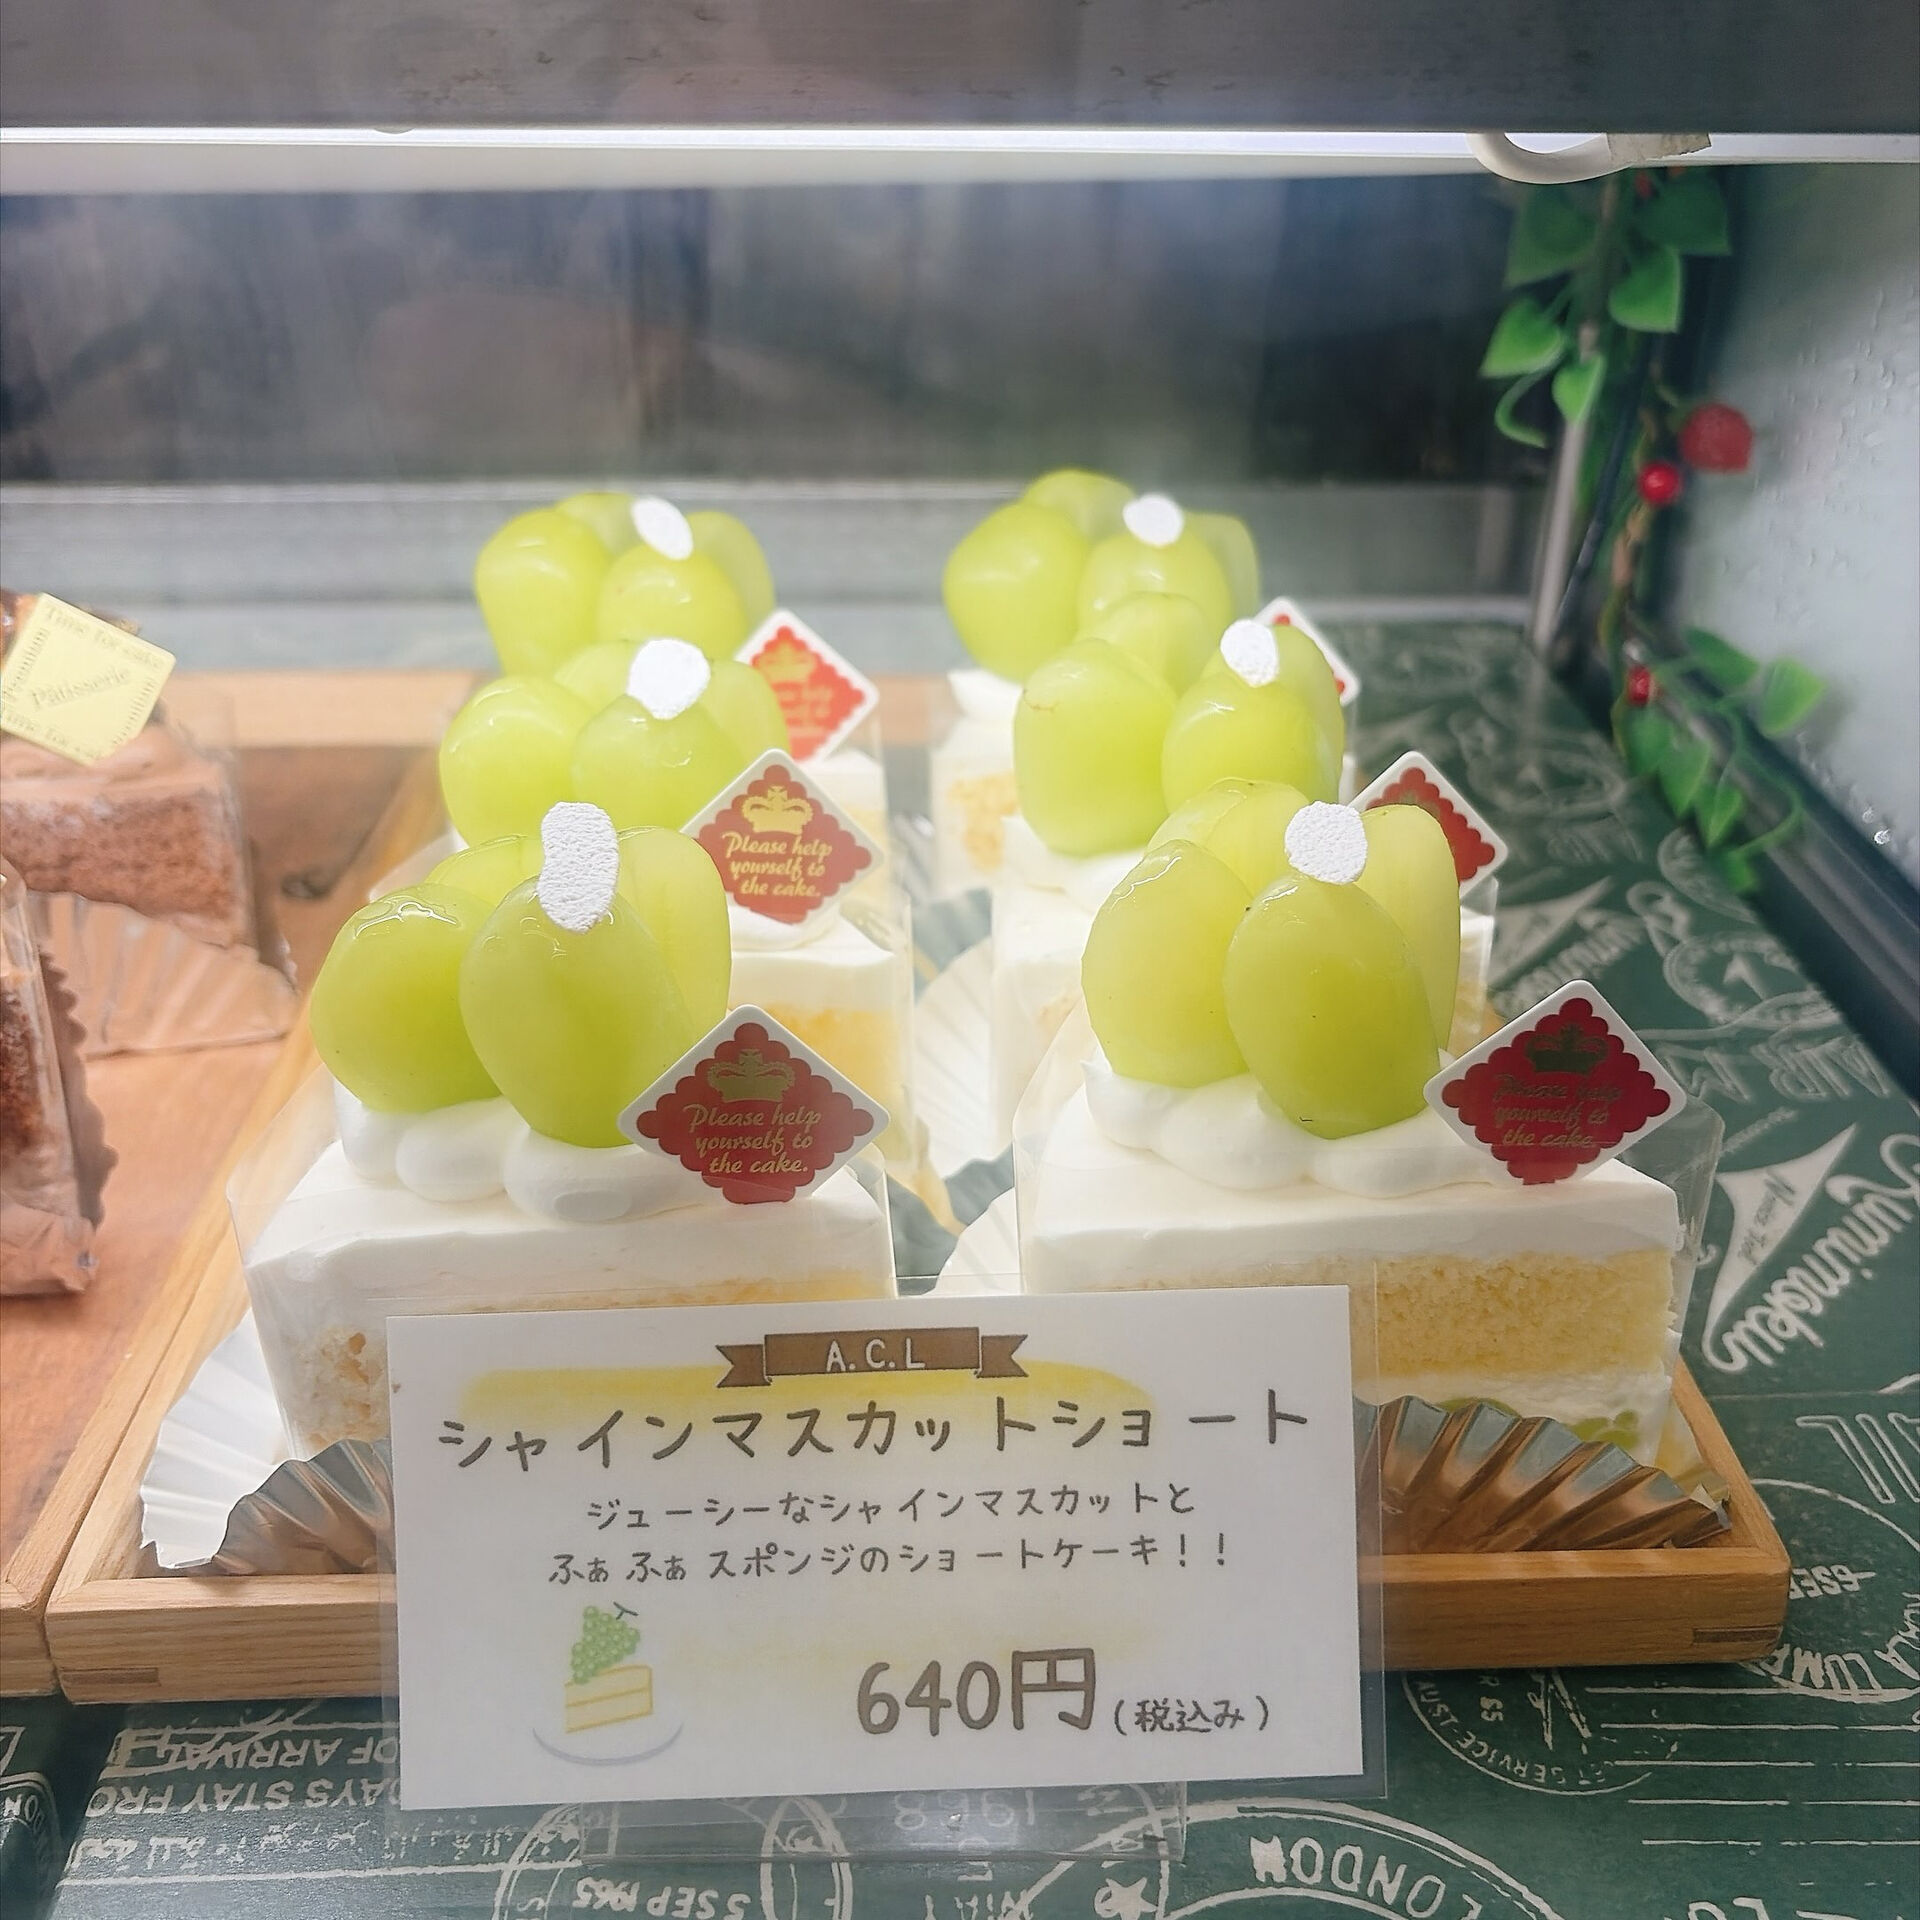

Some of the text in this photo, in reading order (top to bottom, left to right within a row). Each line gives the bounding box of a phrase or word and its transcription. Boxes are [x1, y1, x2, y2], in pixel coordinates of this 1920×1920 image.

[721, 832, 832, 858] Please help
[730, 854, 826, 882] yourself to
[741, 876, 821, 897] the cake.
[684, 1101, 821, 1133] Please help
[1587, 1107, 1611, 1124] to
[695, 1126, 814, 1158] yourself to
[1502, 1123, 1534, 1146] the
[709, 1152, 809, 1174] the cake.
[826, 1338, 925, 1372] A.C.L
[438, 1388, 1307, 1471] シャインマスカットショート
[588, 1482, 1195, 1529] ジューシーなシャインマスカットと
[857, 1648, 1269, 1737] 640円 （税込み）
[347, 1736, 399, 1765] OF
[180, 1780, 294, 1813] STAY
[647, 1886, 718, 1920] SEP
